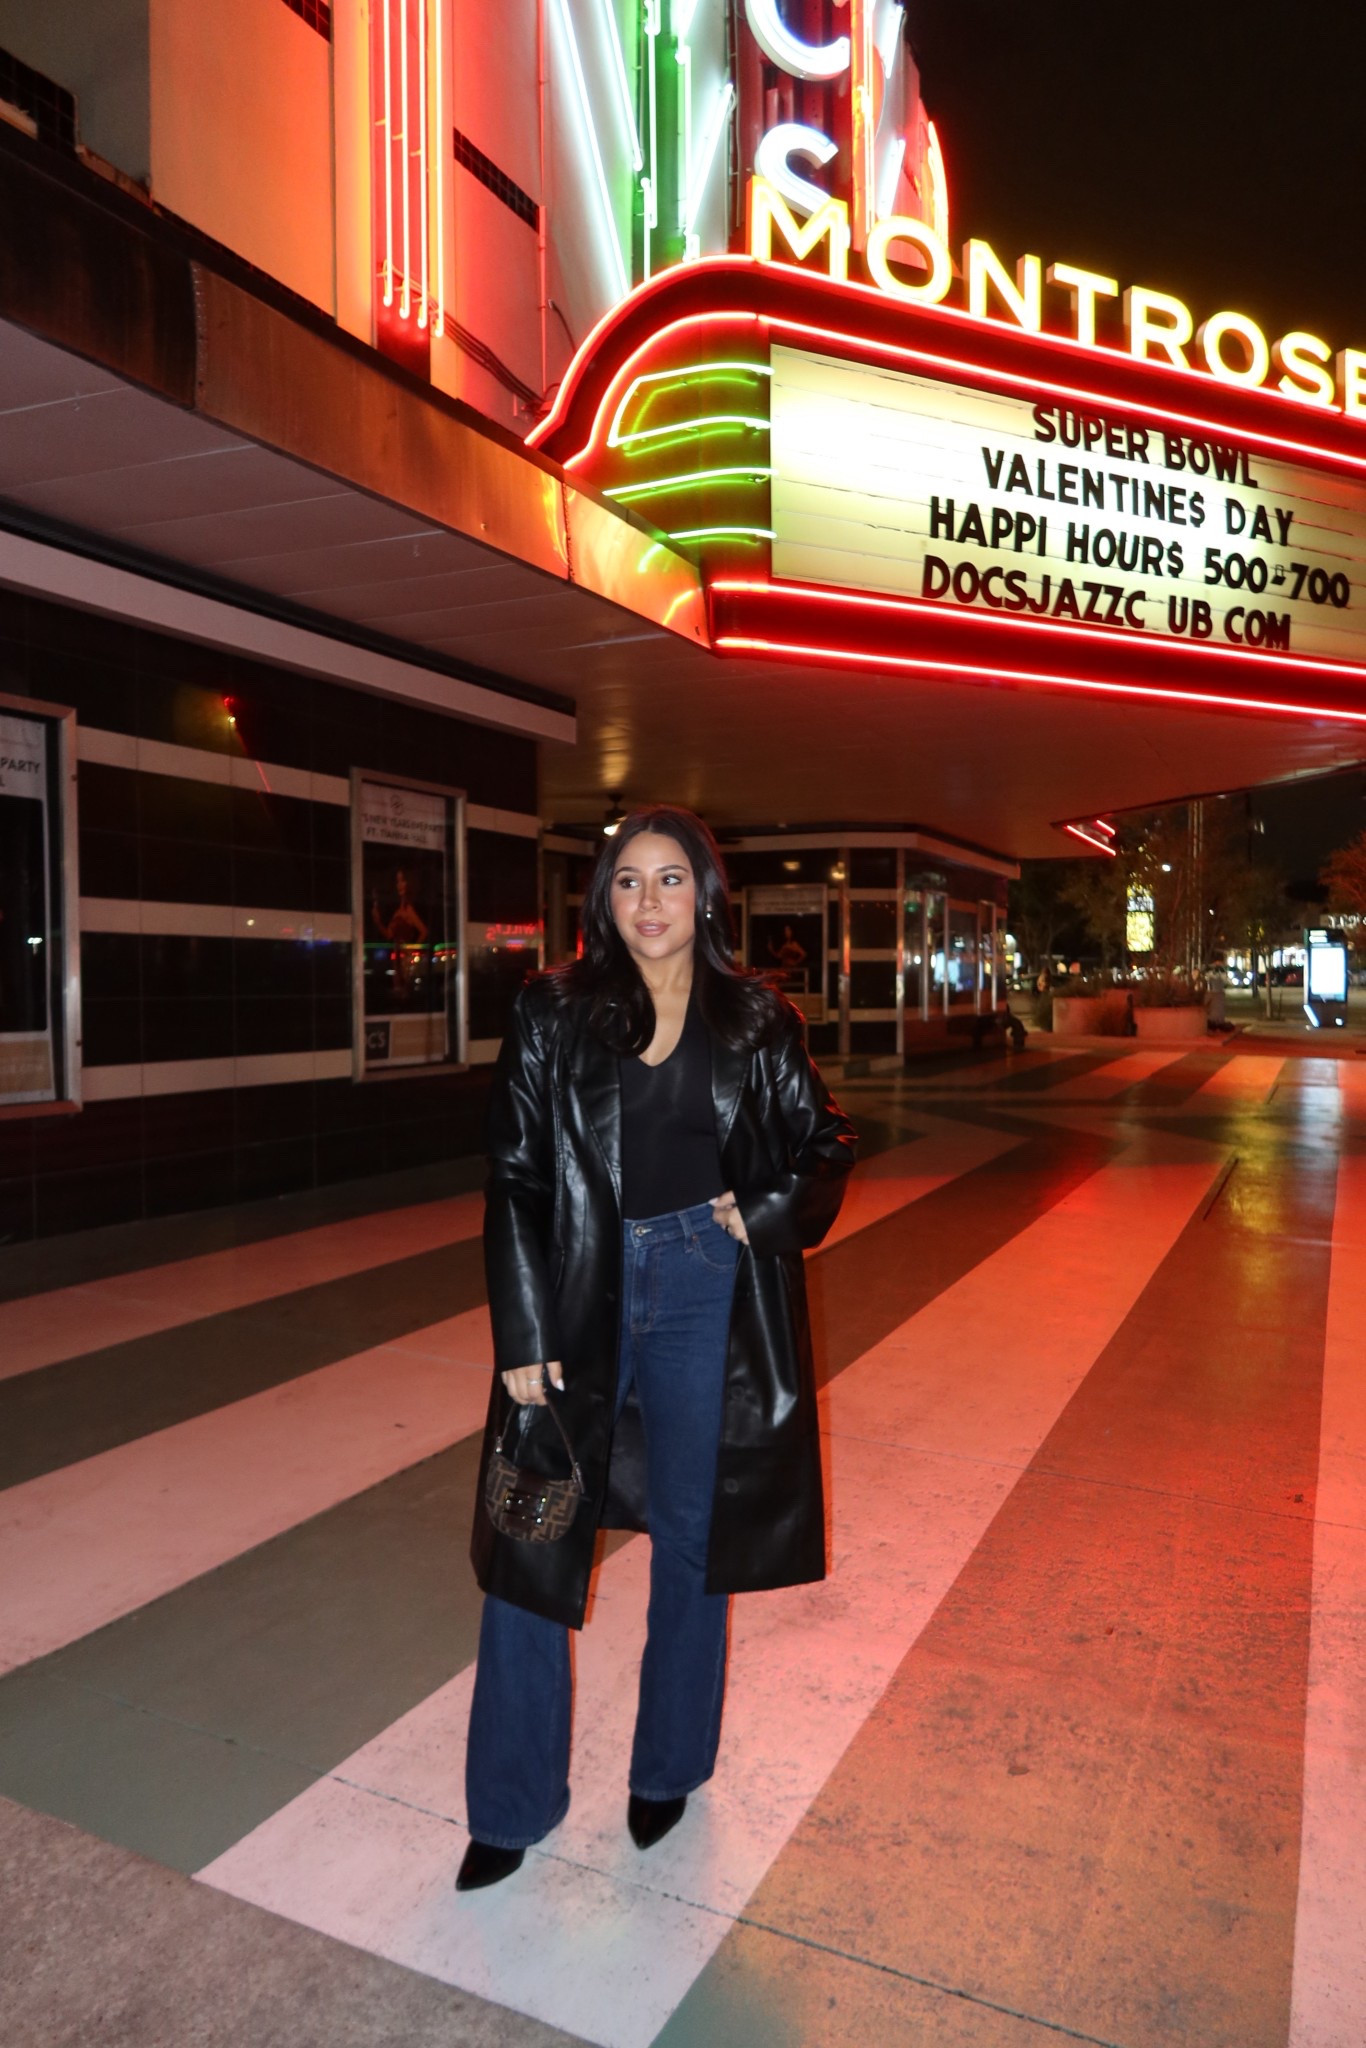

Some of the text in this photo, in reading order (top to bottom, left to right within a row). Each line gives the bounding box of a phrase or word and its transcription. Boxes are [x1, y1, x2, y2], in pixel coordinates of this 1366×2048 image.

[746, 175, 1366, 418] MONTROSE
[1033, 403, 1258, 488] SUPER BOWL
[930, 496, 1047, 557] HAPPI
[1225, 497, 1294, 547] DAY
[1224, 606, 1291, 651] COM
[0, 757, 40, 774] PARTY
